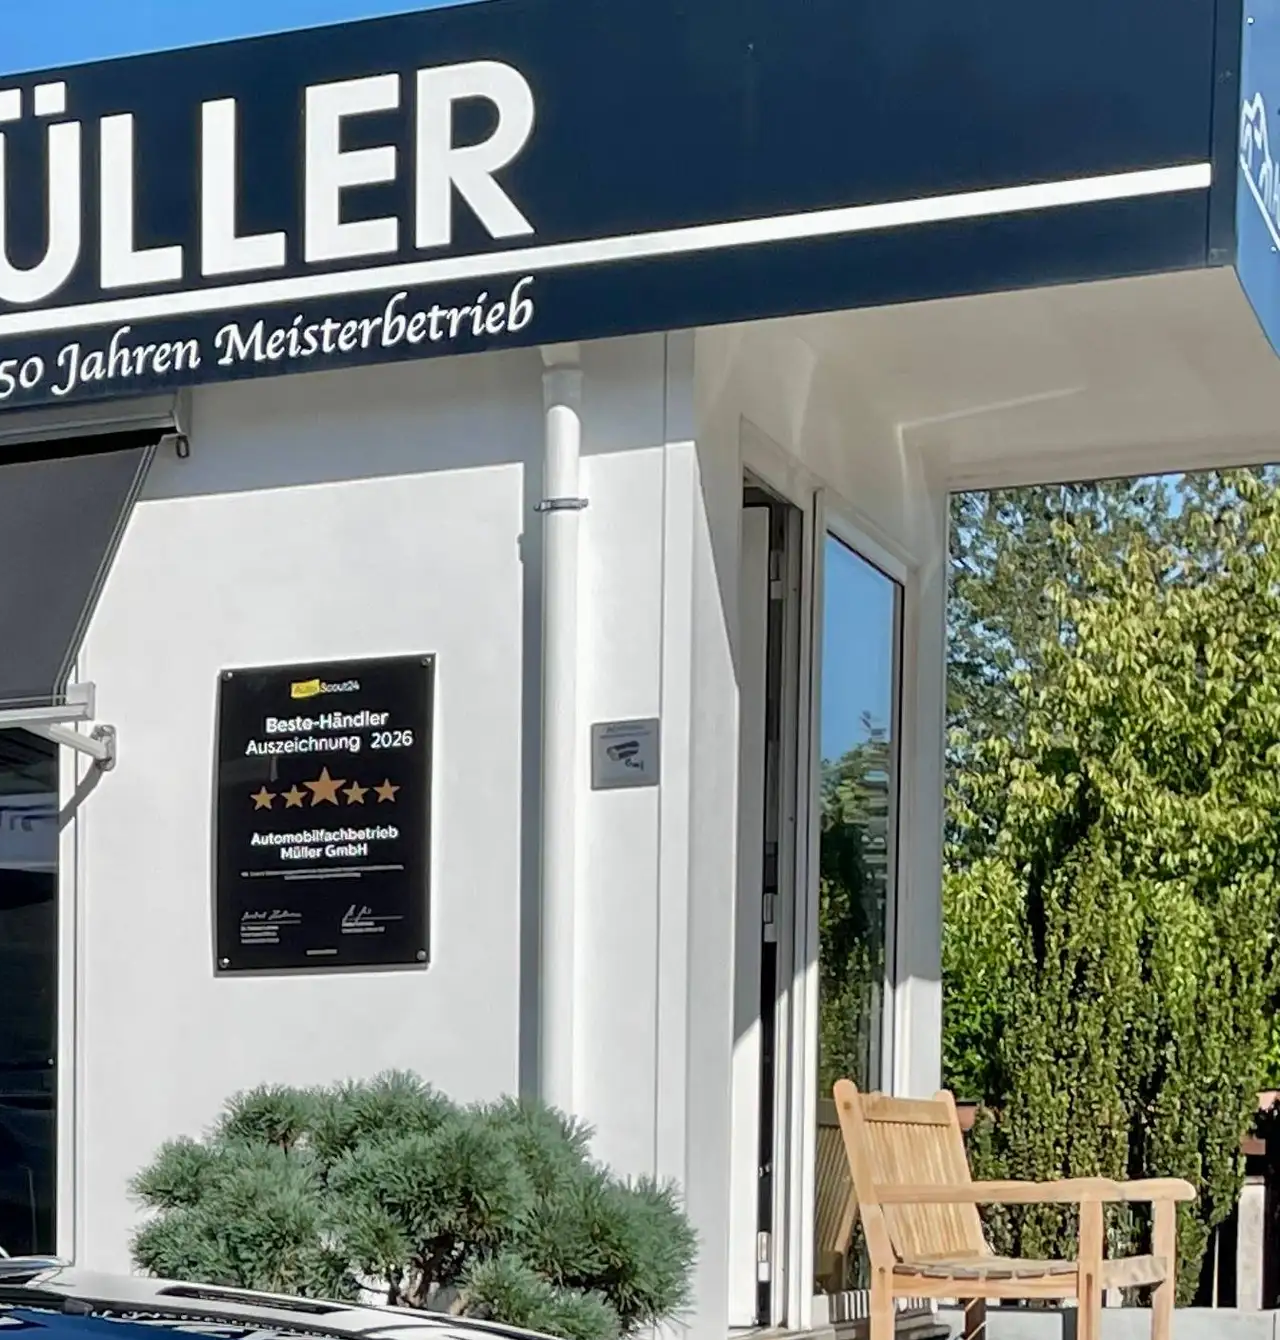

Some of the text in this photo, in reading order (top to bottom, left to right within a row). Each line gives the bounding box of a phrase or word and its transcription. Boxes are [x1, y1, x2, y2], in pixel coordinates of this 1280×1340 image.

[50, 325, 201, 395] Jahren
[214, 276, 534, 367] Meisterbetrieb
[265, 711, 389, 733] Beste-Händler
[245, 730, 413, 755] Auszeichnung 2026
[250, 825, 399, 846] Automobilfachbetrieb
[280, 843, 368, 860] Müller GmbH
